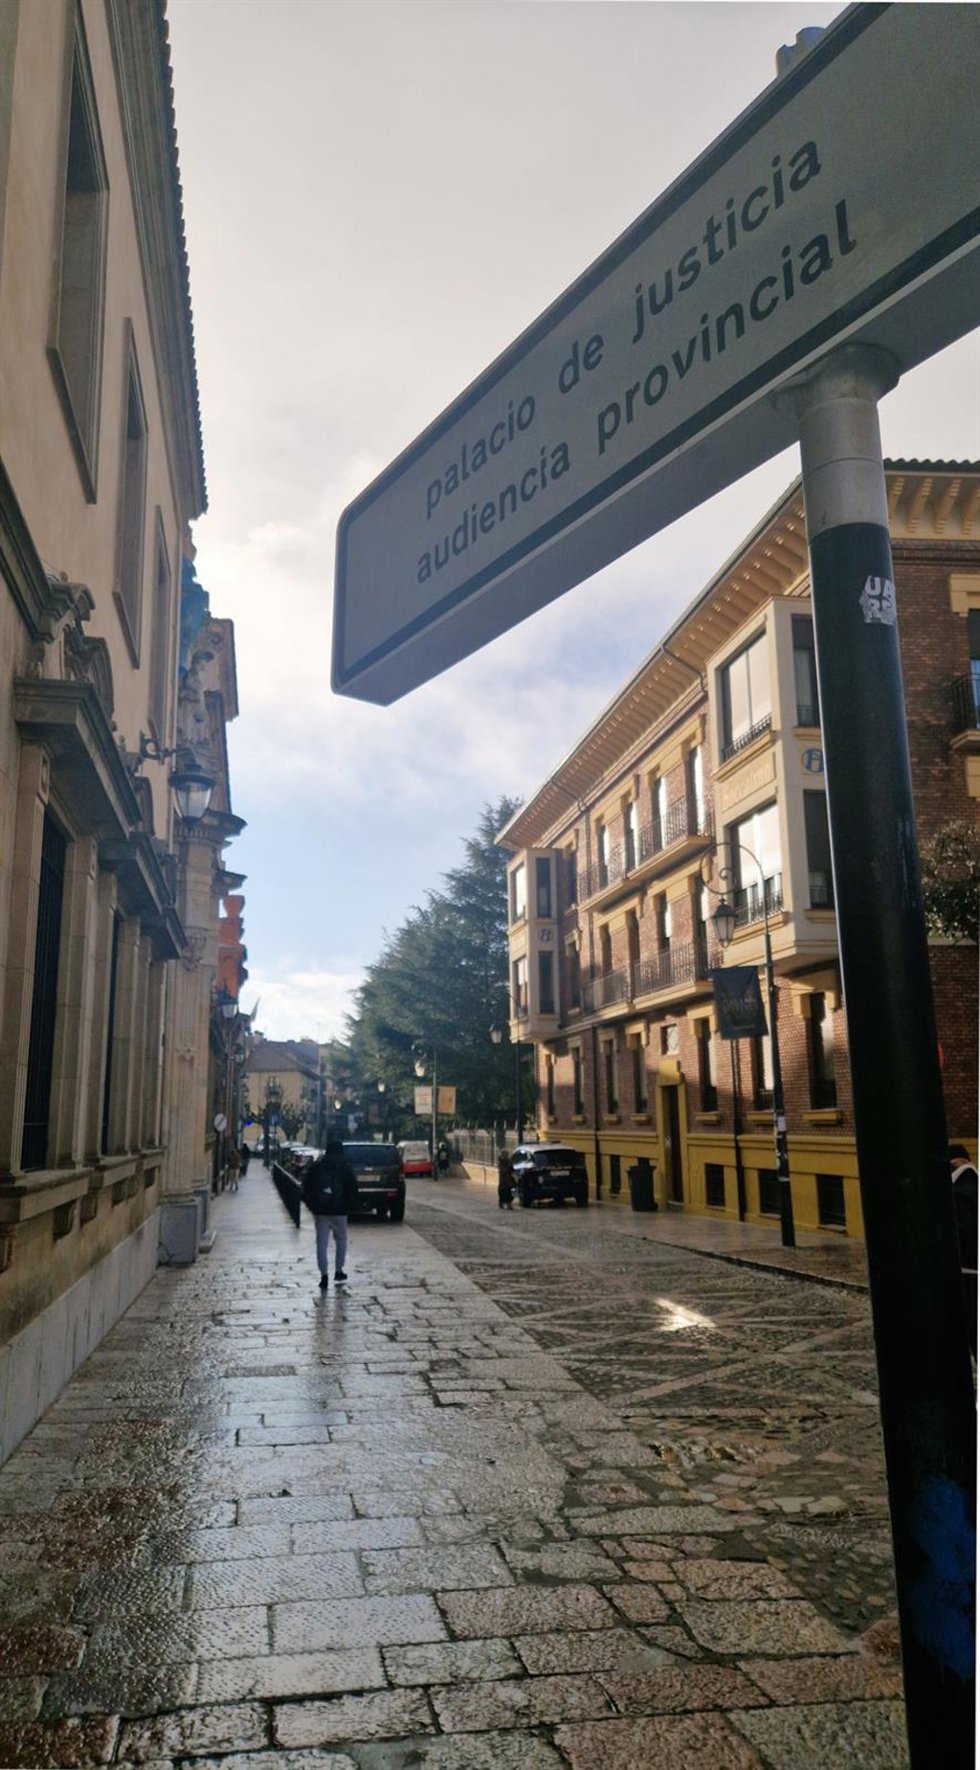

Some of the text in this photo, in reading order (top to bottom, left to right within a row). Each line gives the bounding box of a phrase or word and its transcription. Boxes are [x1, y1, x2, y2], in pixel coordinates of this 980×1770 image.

[417, 199, 857, 583] audiencia provincial
[426, 141, 821, 520] palacio de justicia
